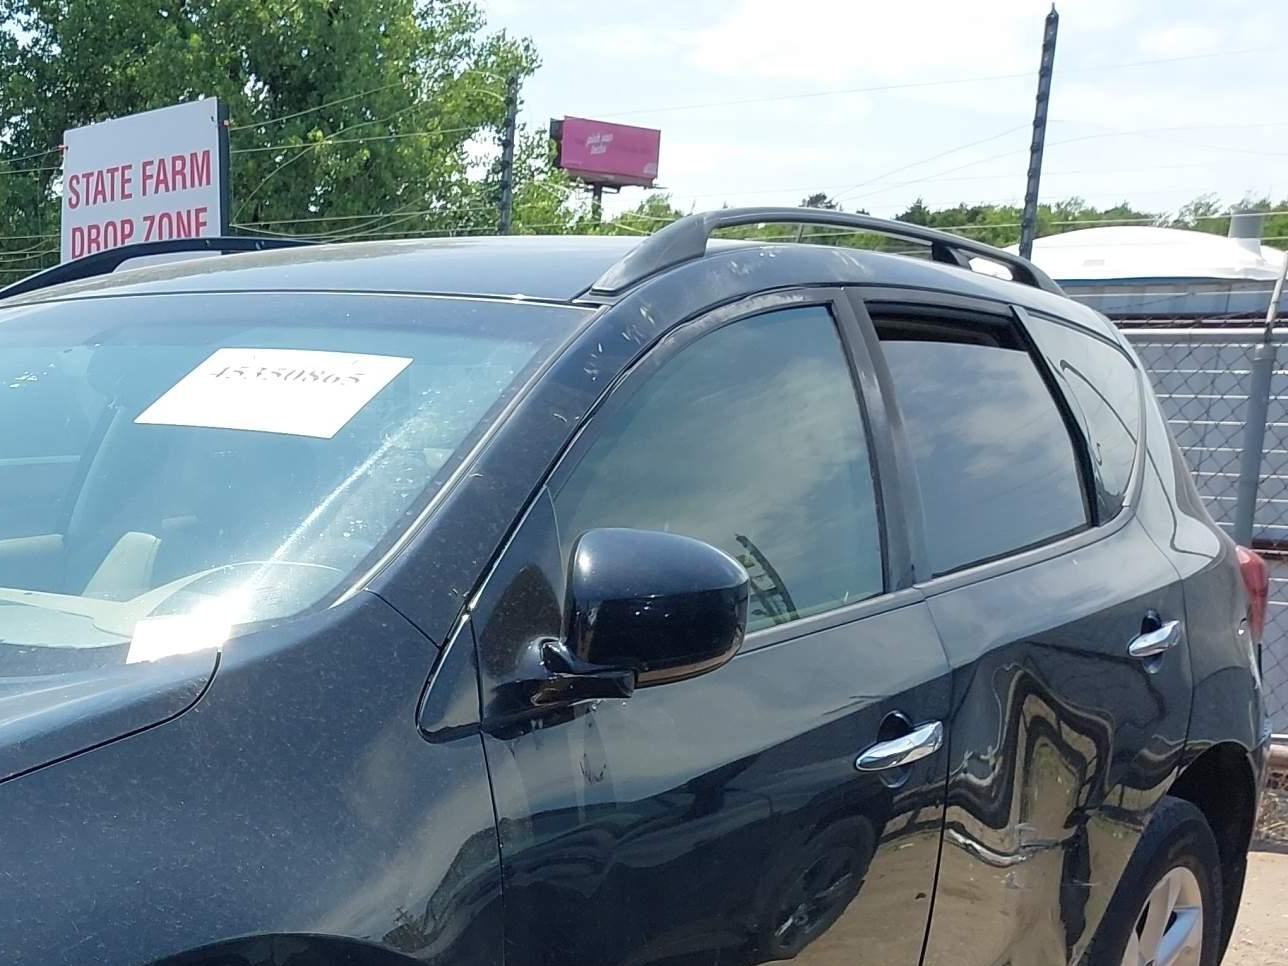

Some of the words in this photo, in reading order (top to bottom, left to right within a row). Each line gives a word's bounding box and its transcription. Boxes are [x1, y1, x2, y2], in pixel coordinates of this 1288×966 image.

[68, 164, 133, 209] STATE
[142, 149, 212, 197] FARM
[71, 218, 135, 259] DROP
